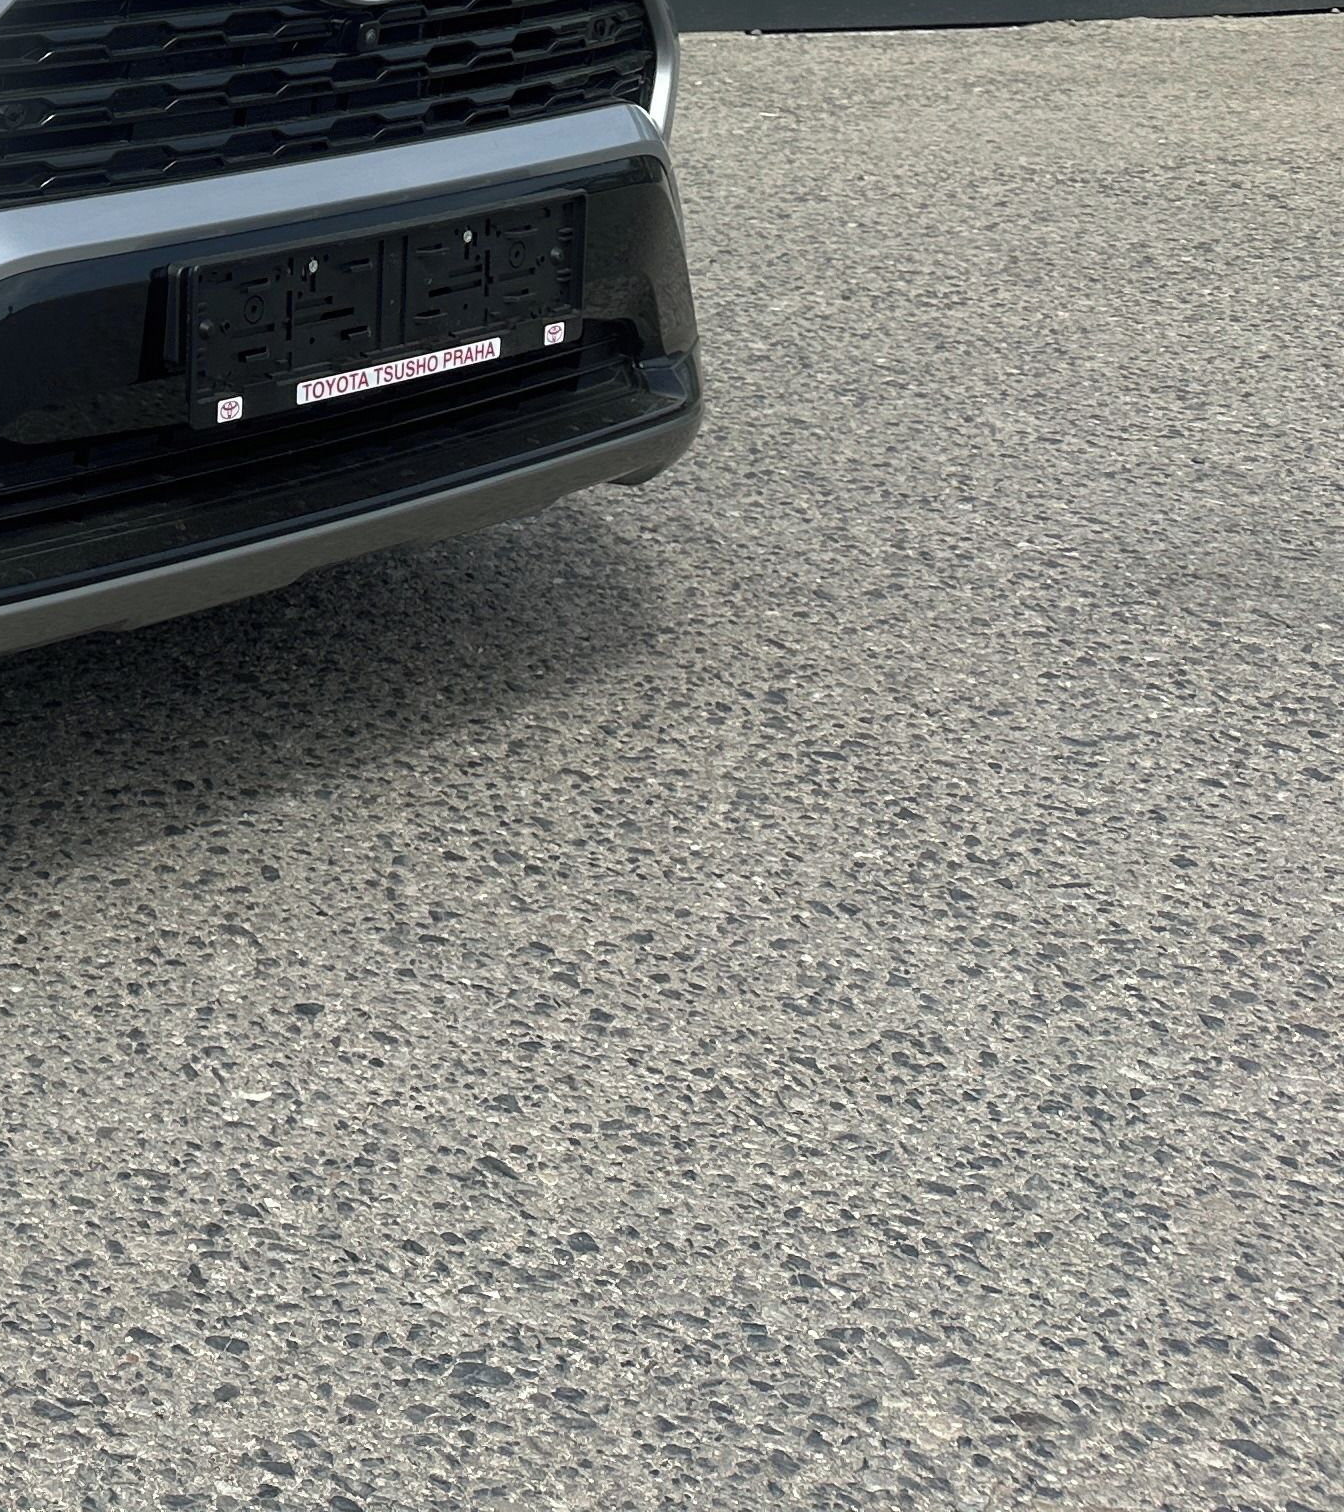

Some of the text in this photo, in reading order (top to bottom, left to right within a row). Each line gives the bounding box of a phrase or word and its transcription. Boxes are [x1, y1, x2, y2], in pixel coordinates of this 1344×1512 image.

[301, 341, 496, 402] TOYOTA TSUSHO PRAHA
